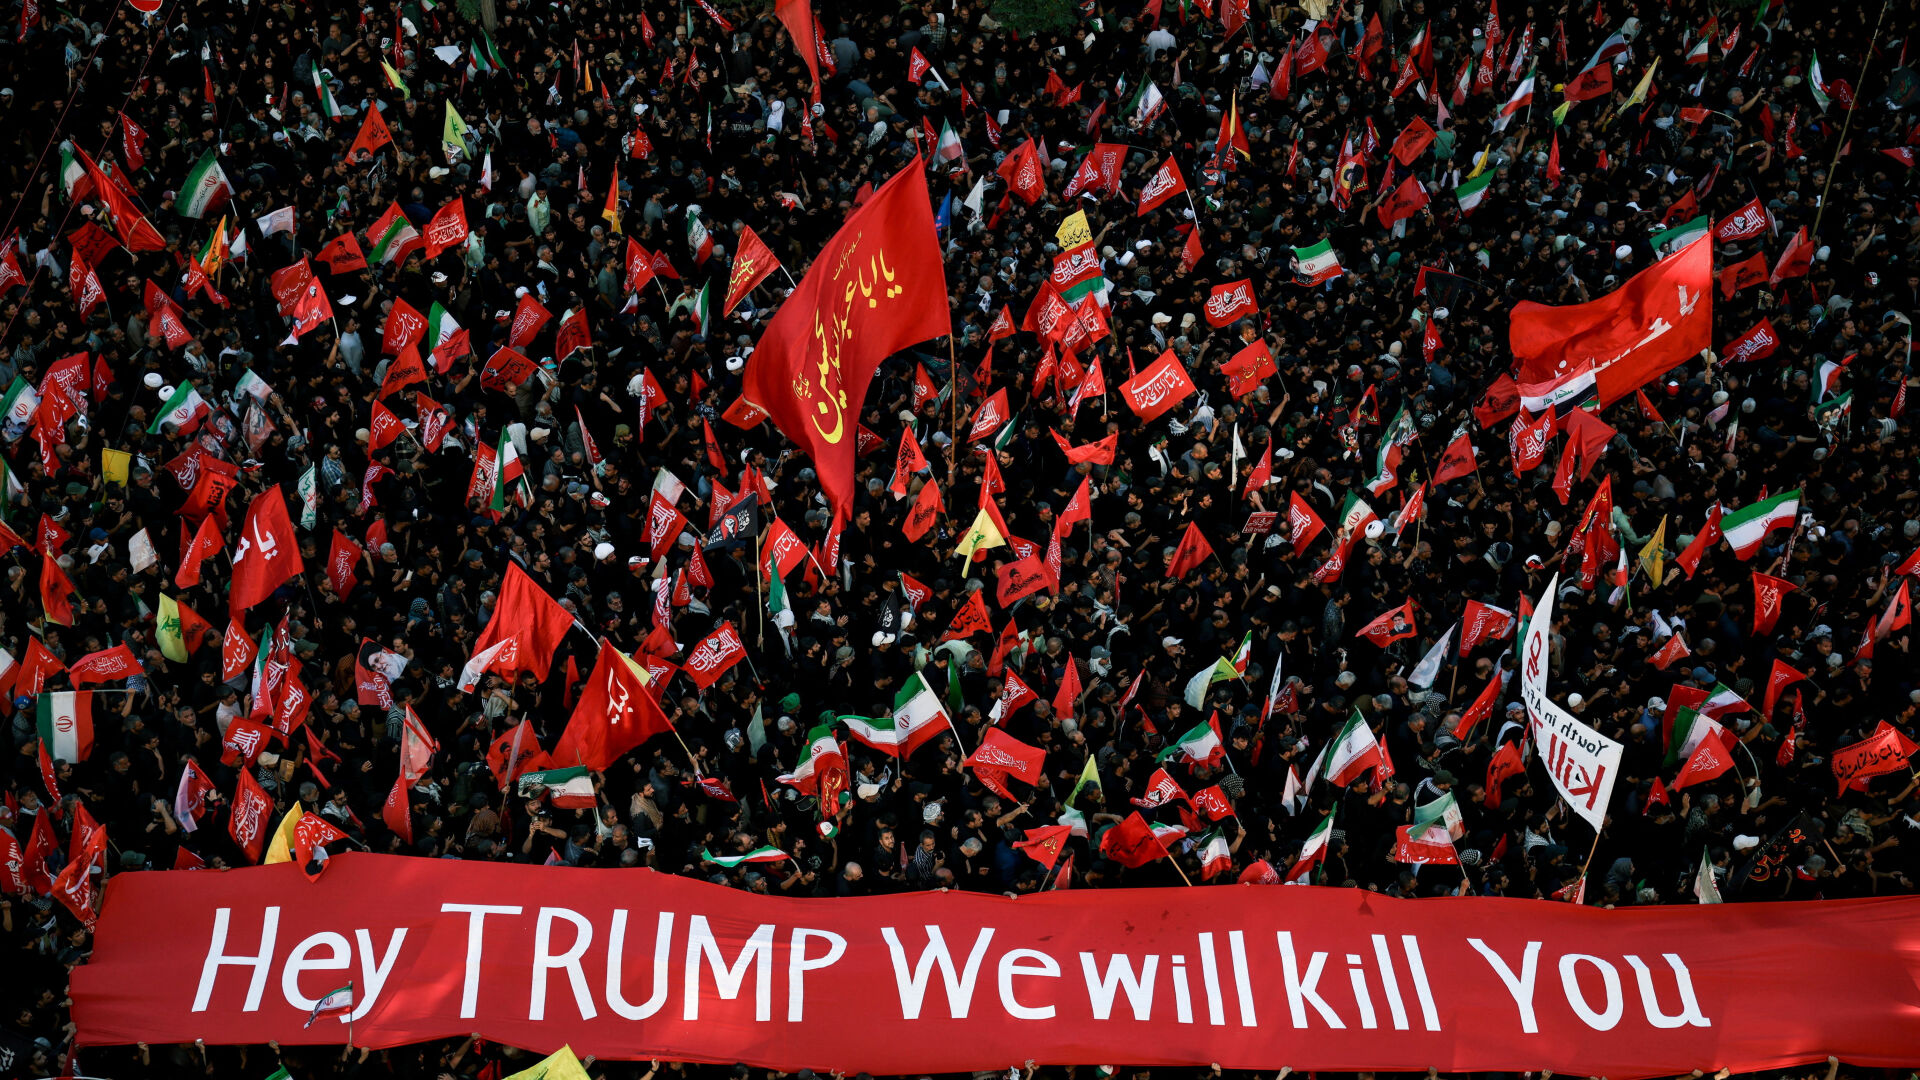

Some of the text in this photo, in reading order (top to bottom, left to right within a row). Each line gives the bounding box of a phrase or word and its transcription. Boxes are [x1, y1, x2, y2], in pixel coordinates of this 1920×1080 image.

[191, 902, 1712, 1034] Hey TRUMP We will kill You
